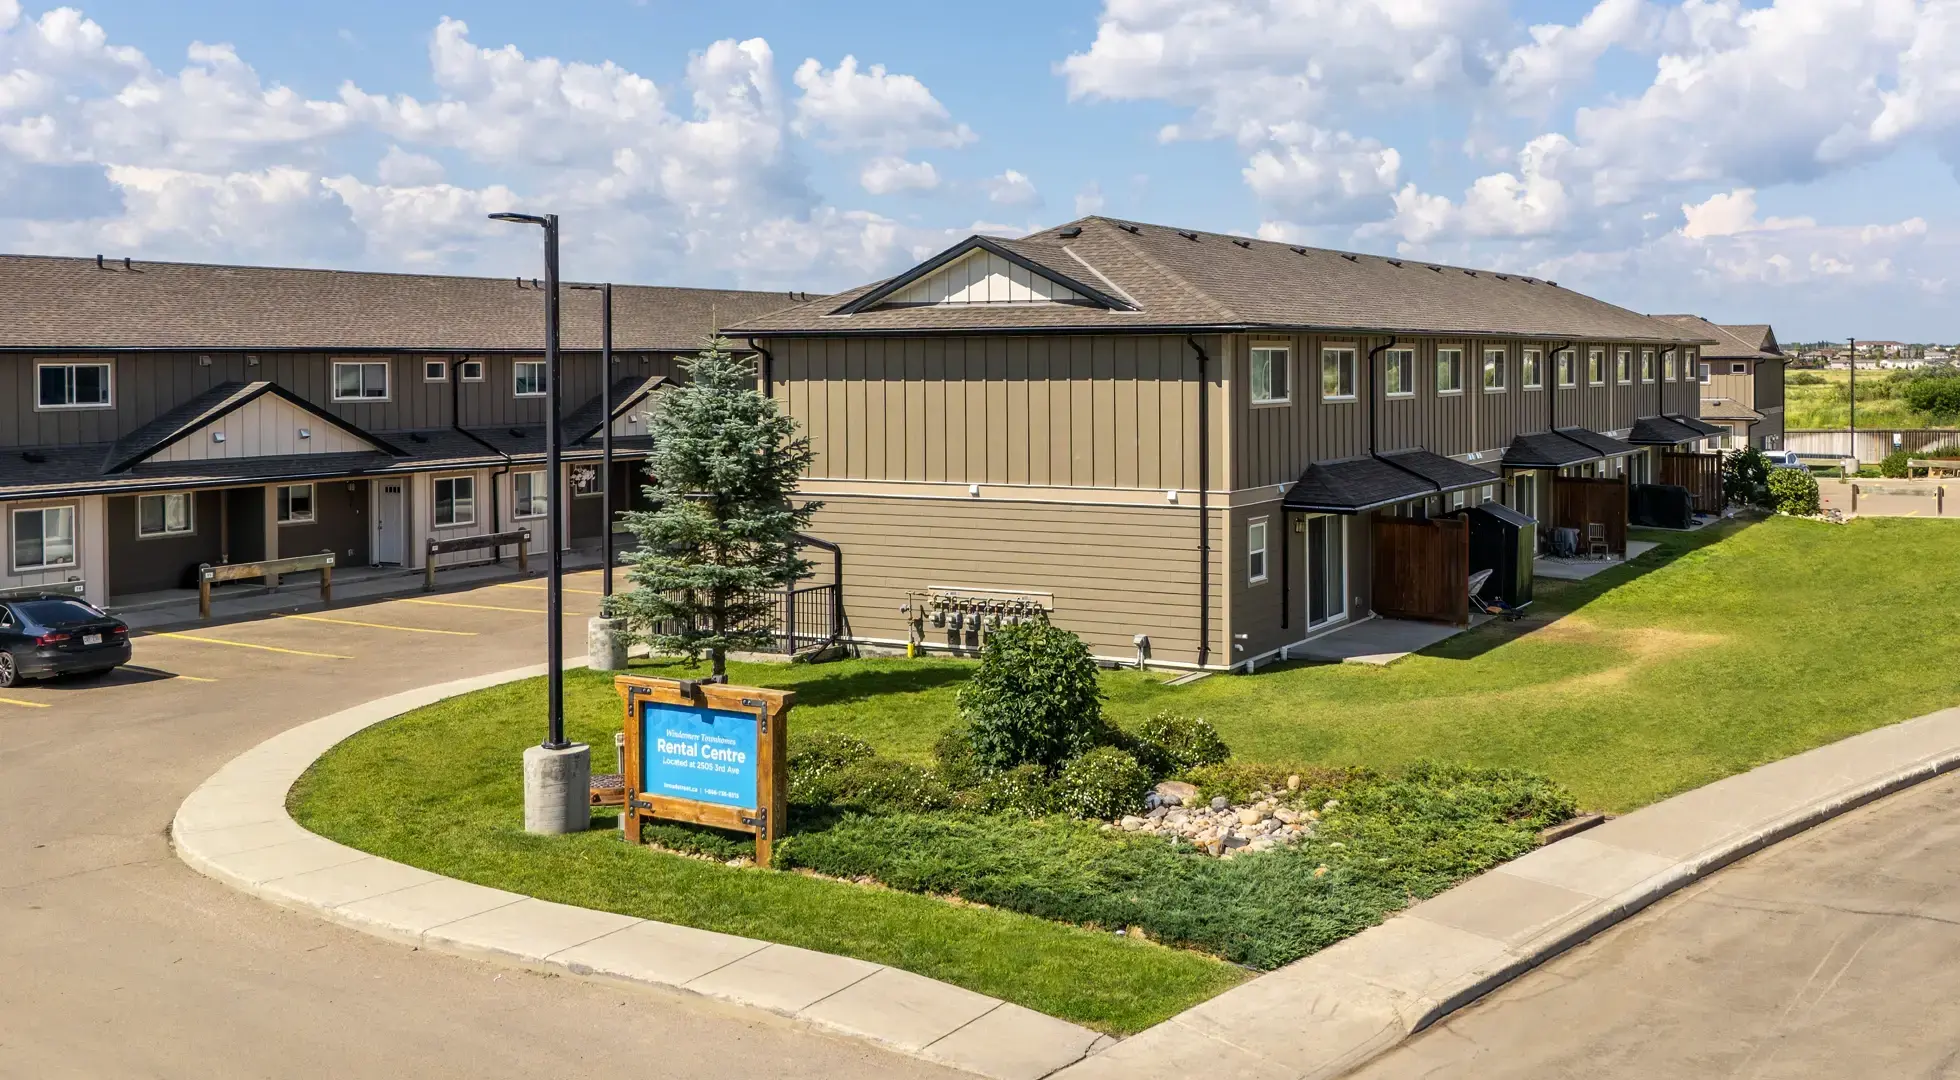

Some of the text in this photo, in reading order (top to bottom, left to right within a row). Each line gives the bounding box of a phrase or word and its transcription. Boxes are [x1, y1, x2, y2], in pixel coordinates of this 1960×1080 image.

[666, 729, 736, 746] Windermere Townhomes
[657, 738, 746, 763] Rental Centre
[663, 757, 740, 775] Located at 2505 3rd Ave
